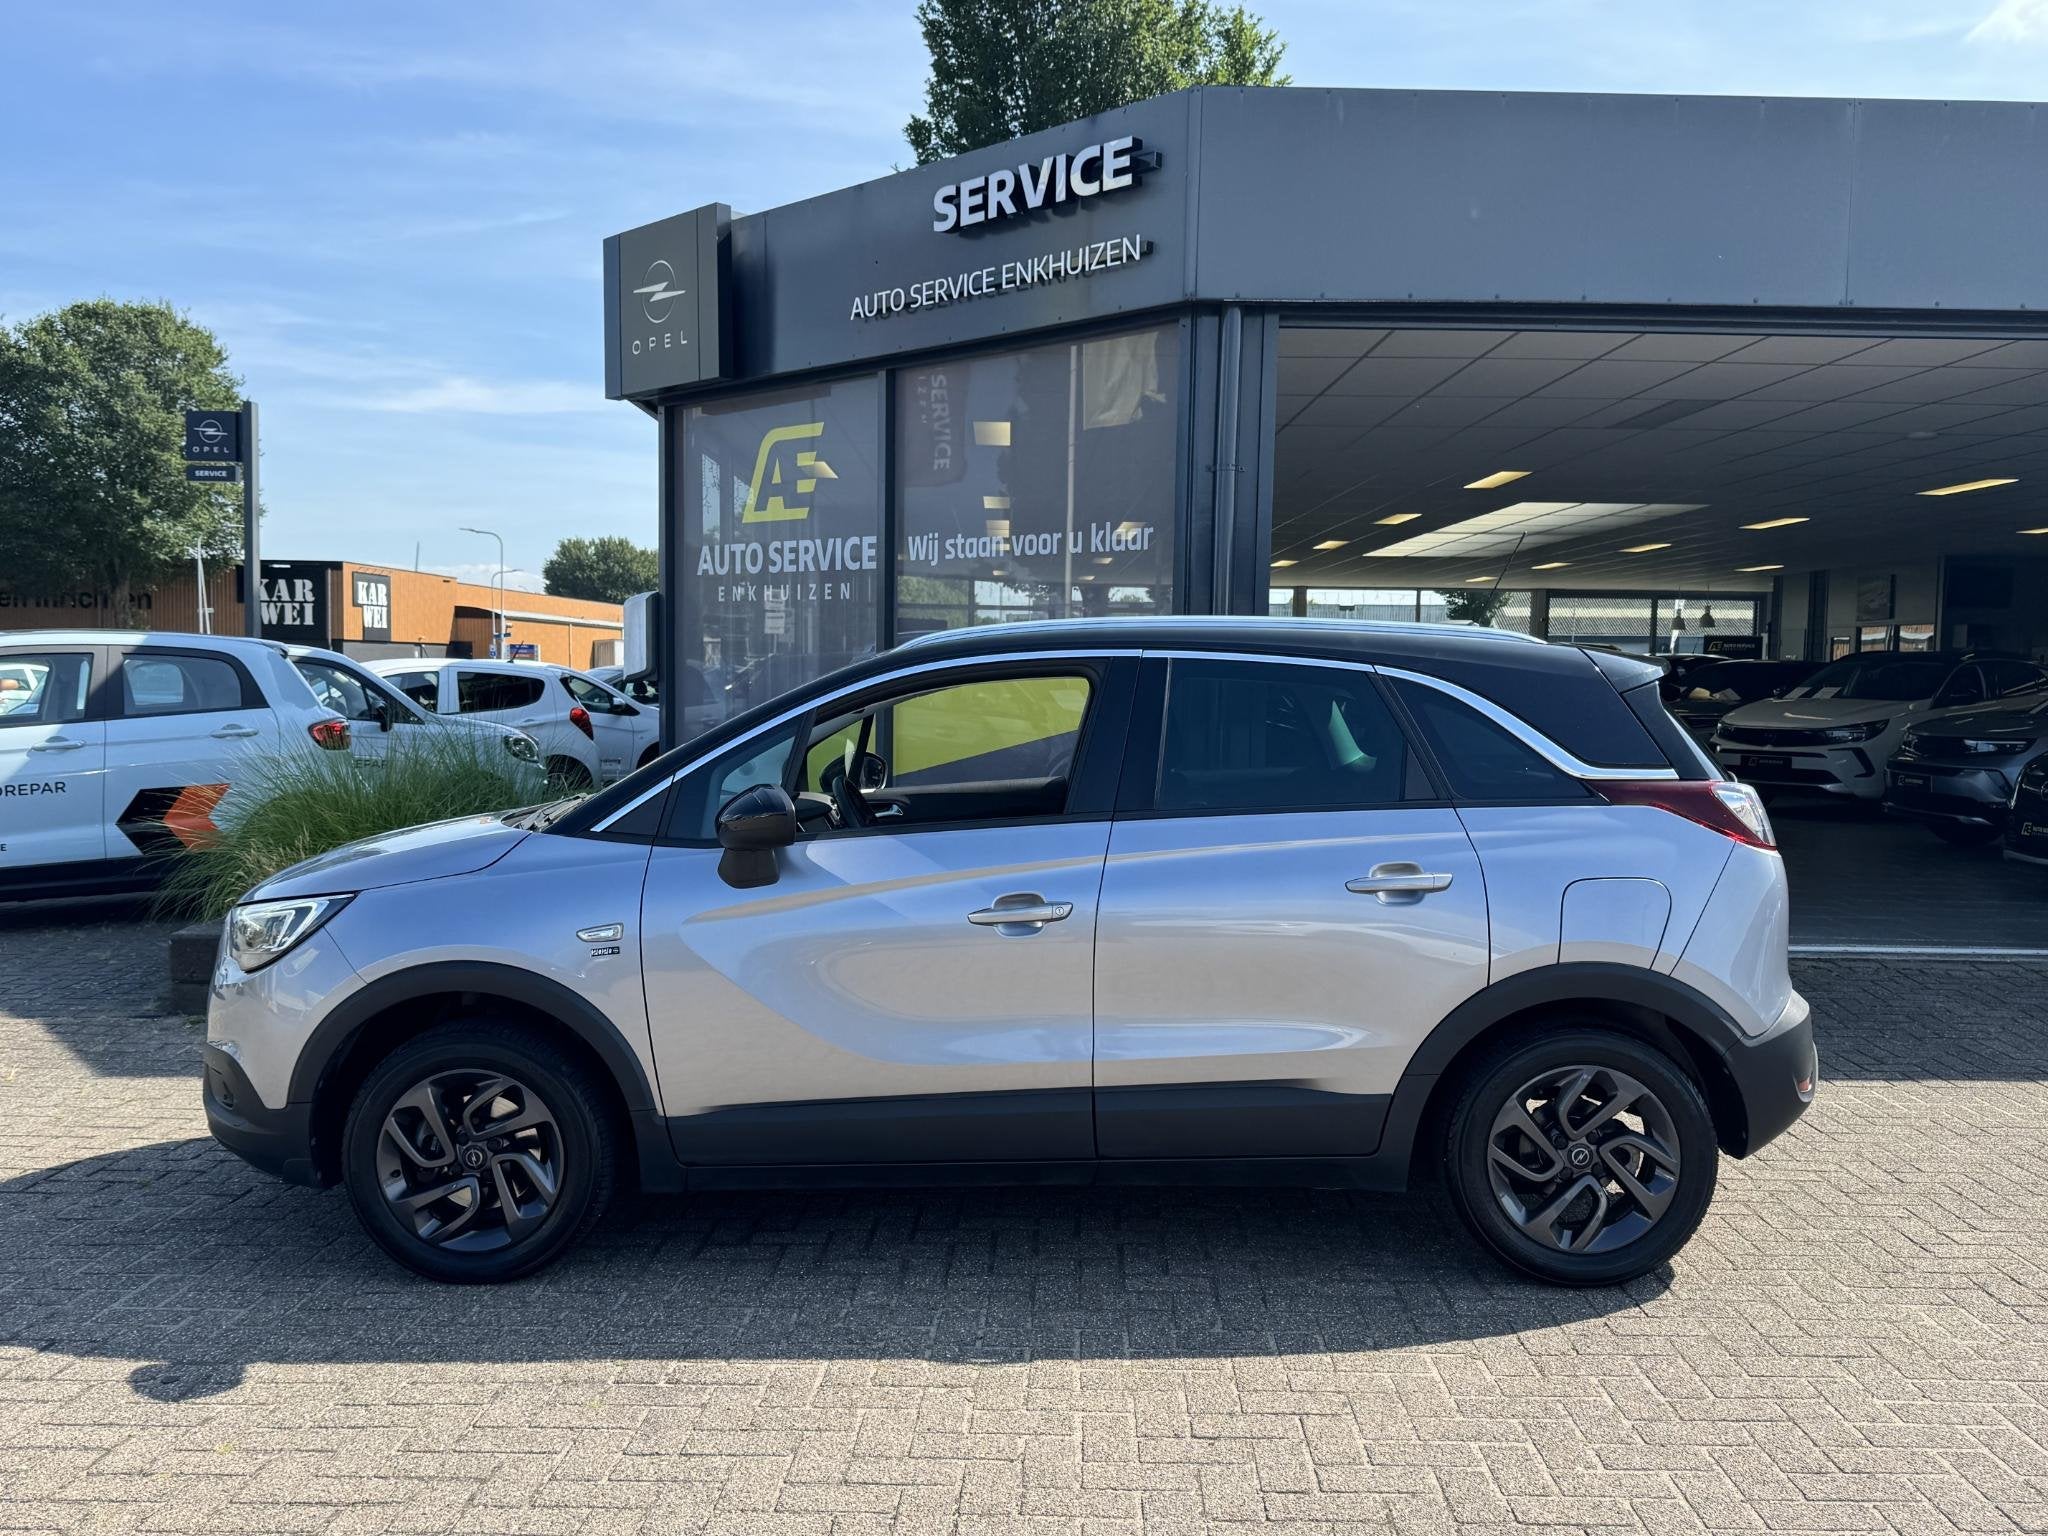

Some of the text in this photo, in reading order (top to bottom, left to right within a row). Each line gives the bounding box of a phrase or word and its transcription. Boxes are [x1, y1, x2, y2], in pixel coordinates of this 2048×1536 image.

[933, 136, 1134, 232] SERVICE
[850, 234, 1140, 320] AUTO SERVICE ENKHUIZEN
[632, 330, 688, 355] OPEL
[931, 374, 951, 471] SERVICE
[192, 446, 230, 454] OPEL
[697, 536, 877, 576] AUTO SERVICE
[908, 521, 1154, 567] Wij staan voor u klaar
[260, 579, 316, 602] KAR
[357, 581, 388, 606] KAR
[718, 583, 851, 602] ENKHUIZEN
[261, 603, 315, 625] WEI
[363, 605, 388, 628] WEI
